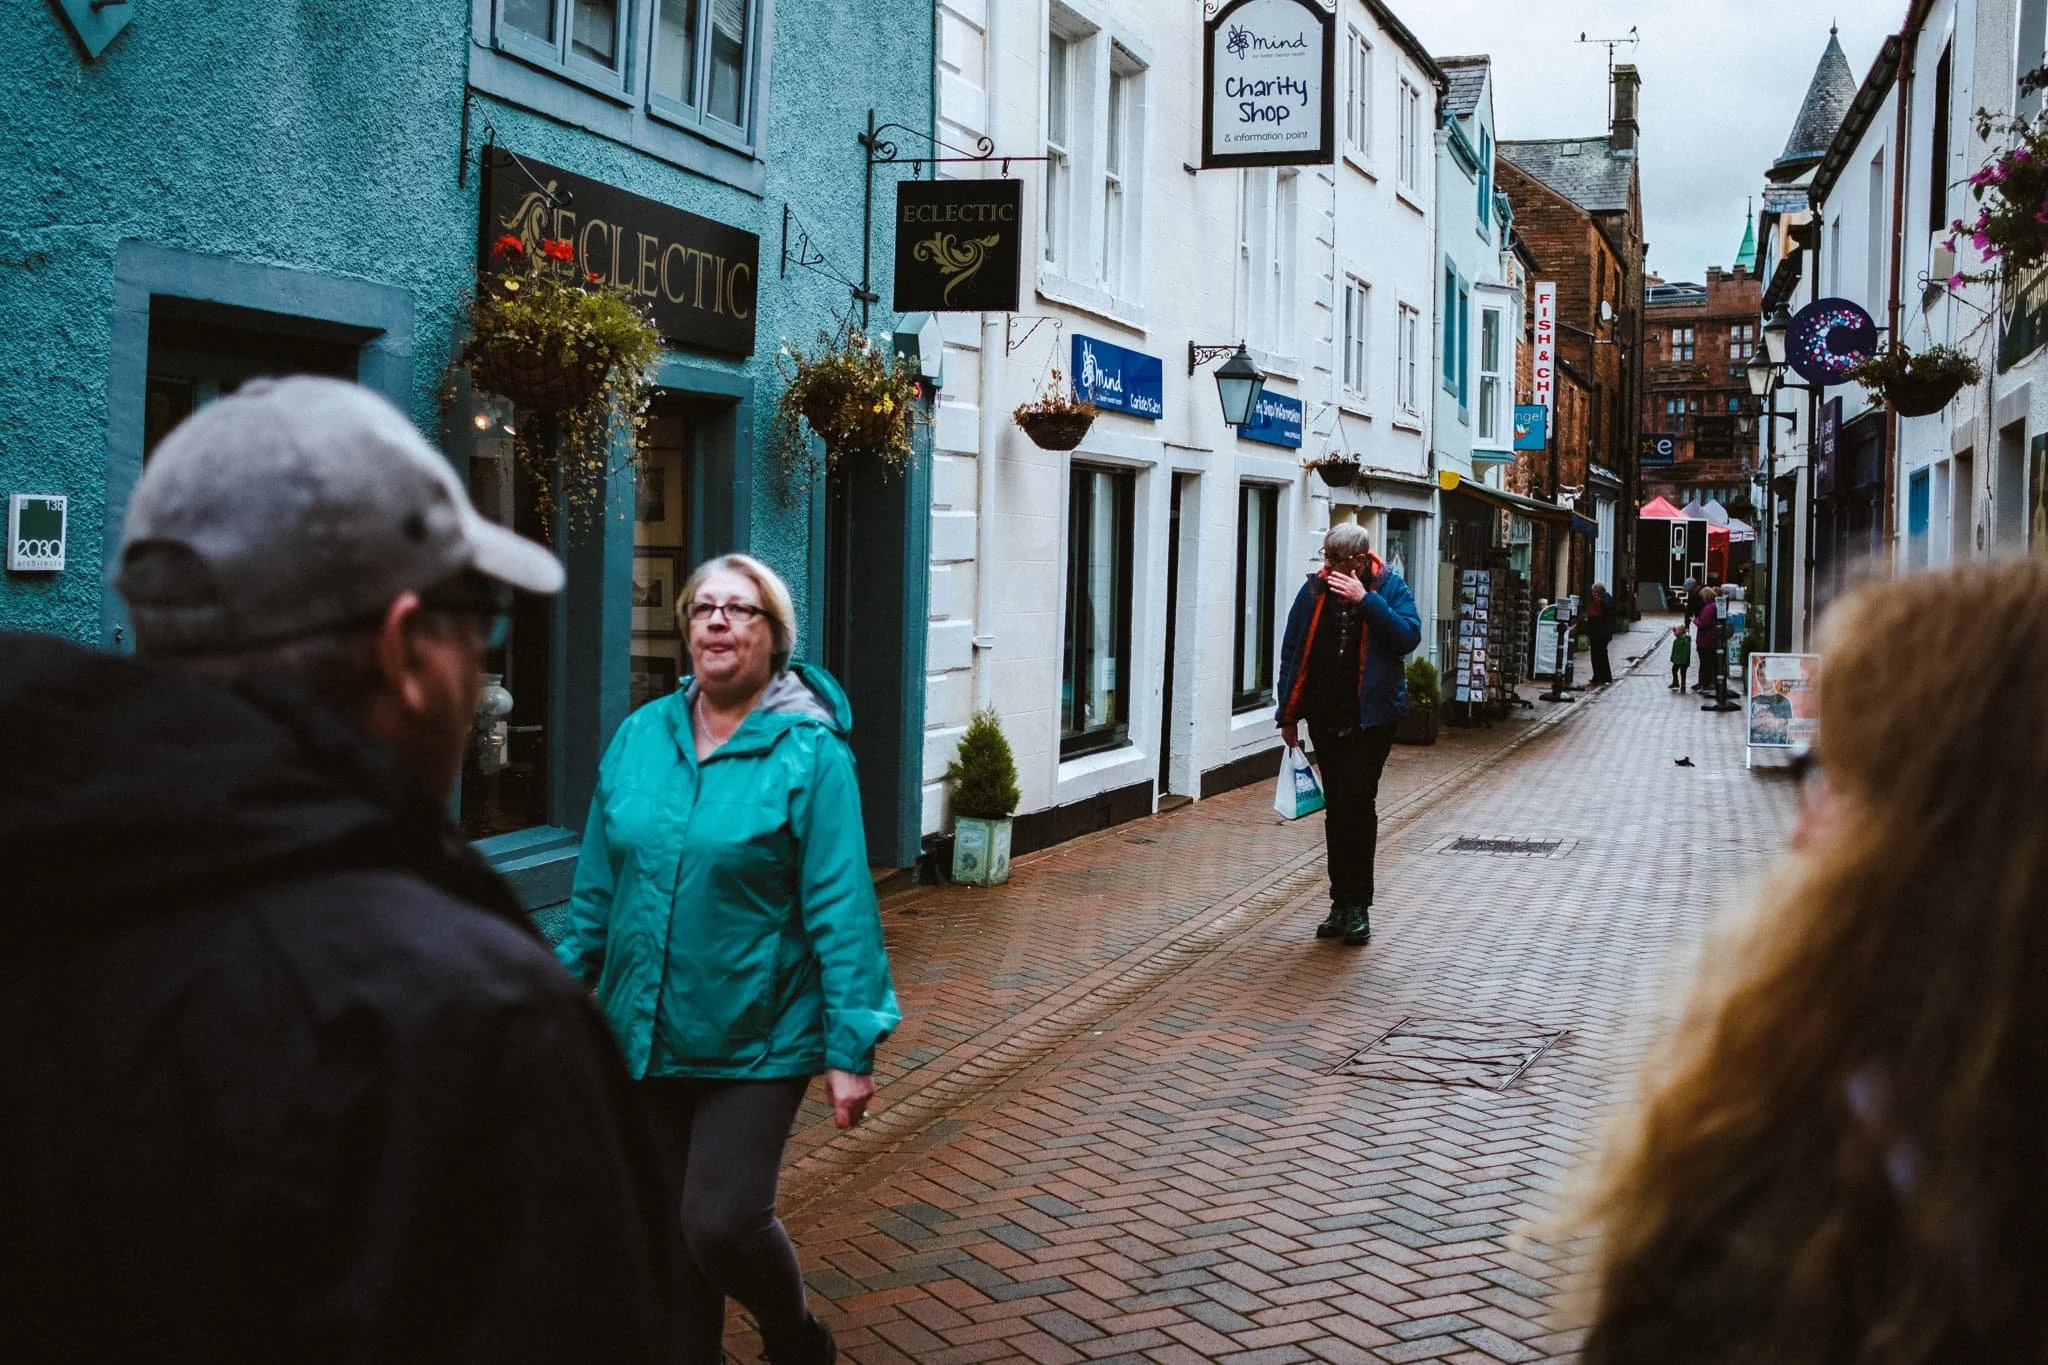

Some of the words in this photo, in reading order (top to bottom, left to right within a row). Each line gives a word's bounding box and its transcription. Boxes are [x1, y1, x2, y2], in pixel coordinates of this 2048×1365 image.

[1253, 32, 1308, 50] mind
[1226, 76, 1308, 106] Charity
[1239, 101, 1290, 126] Shop
[1224, 134, 1231, 142] &
[1234, 131, 1283, 142] information
[1286, 131, 1308, 141] point
[903, 203, 1013, 222] ECLECTIC
[553, 207, 750, 320] ECLECTIC
[1537, 294, 1551, 344] FISH
[1539, 350, 1549, 361] &
[1095, 368, 1123, 393] mind
[1515, 407, 1543, 424] ngel
[18, 539, 61, 558] 2030
